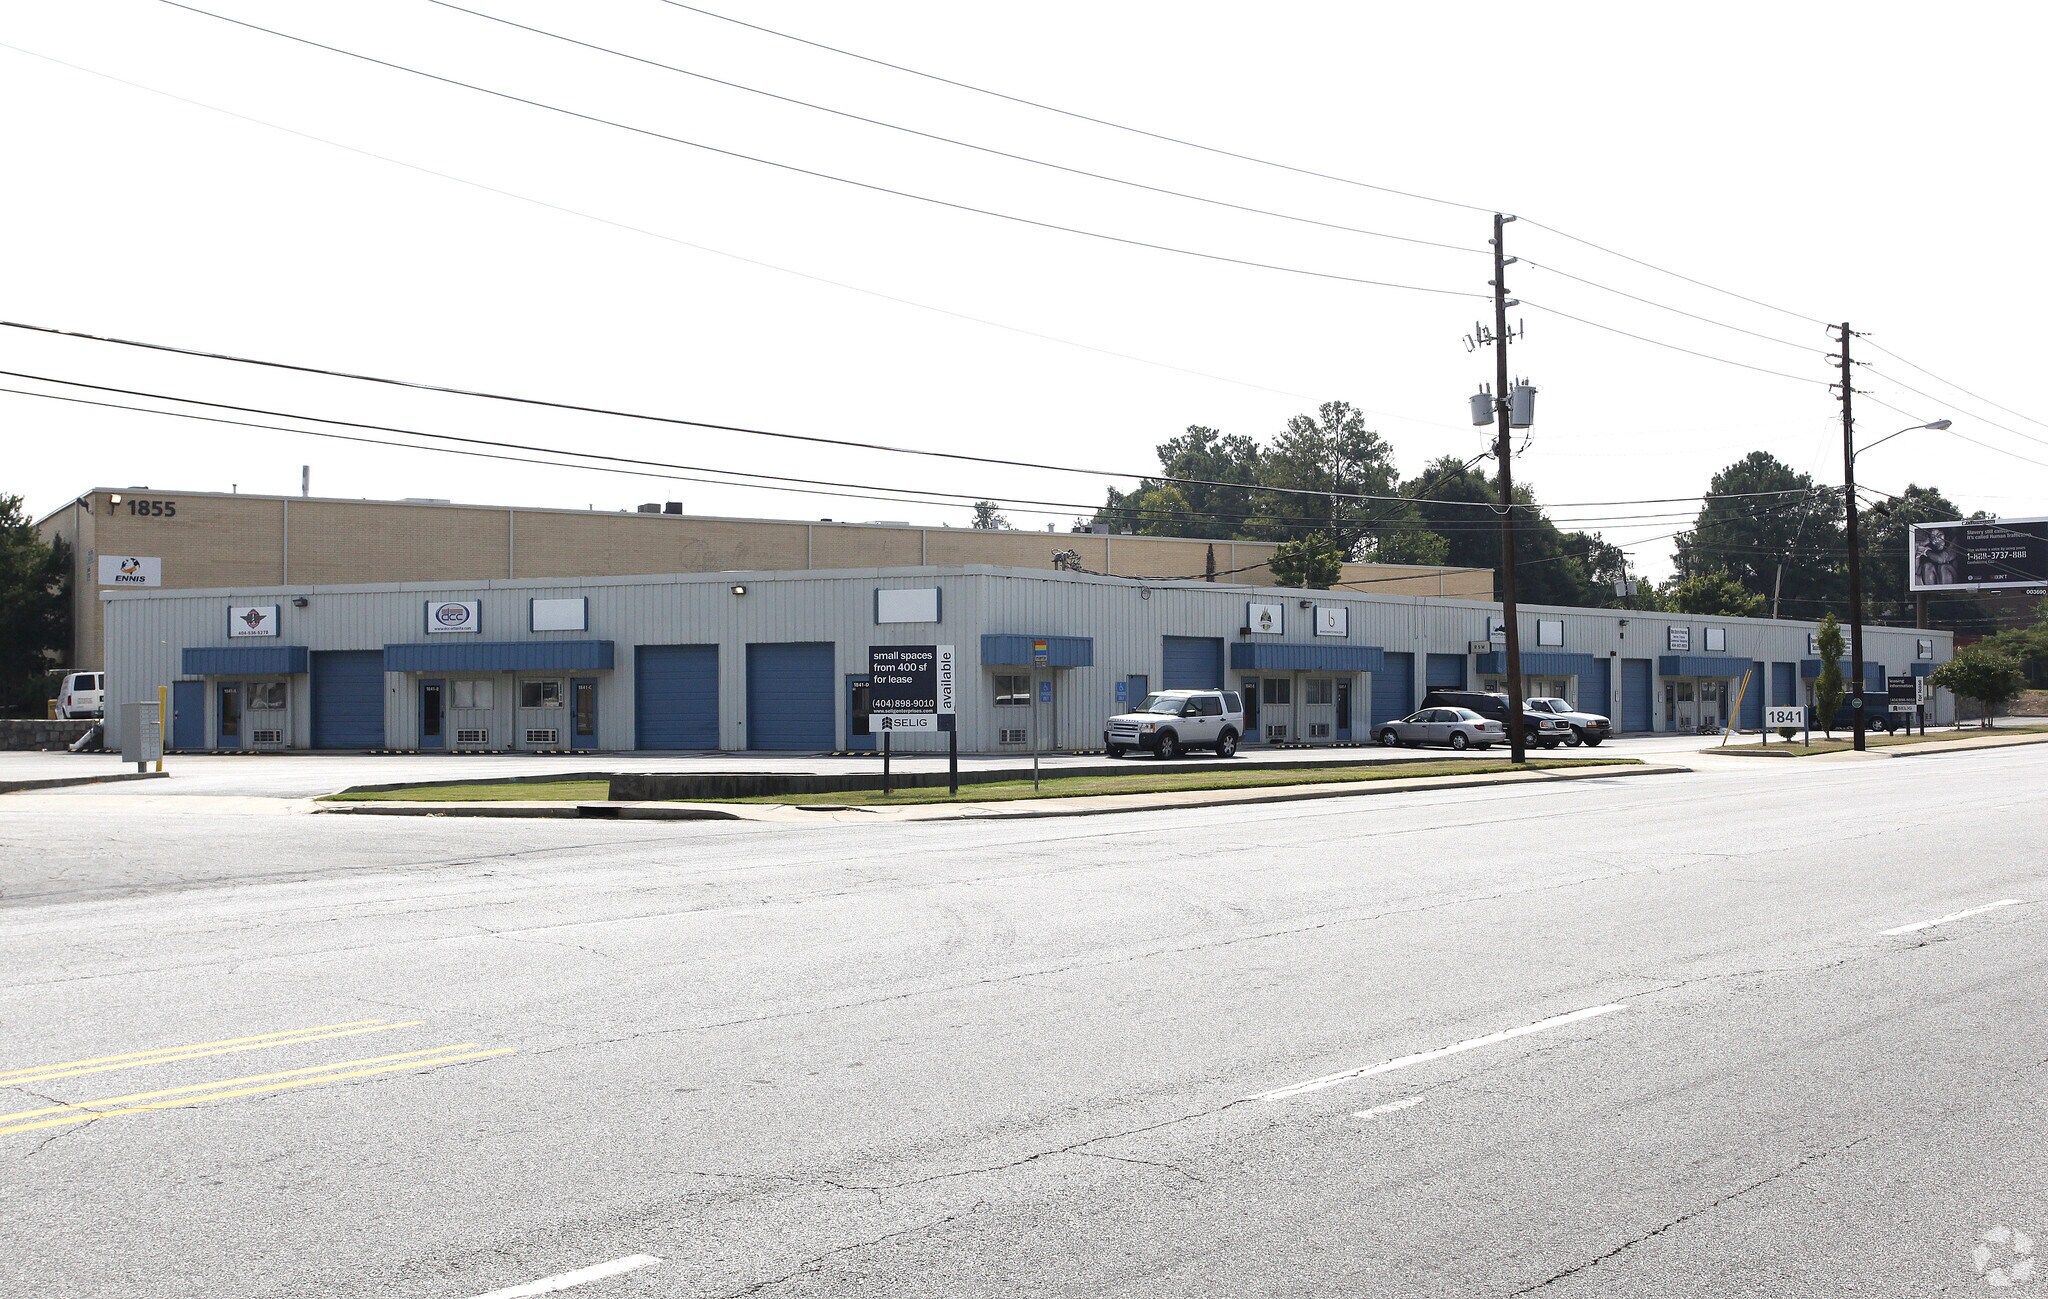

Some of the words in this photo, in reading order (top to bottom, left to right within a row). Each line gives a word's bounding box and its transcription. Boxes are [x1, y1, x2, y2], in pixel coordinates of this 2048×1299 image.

[127, 500, 176, 517] 1855
[115, 575, 146, 583] ENNIS
[873, 651, 899, 660] small
[900, 652, 933, 662] spaces
[873, 663, 896, 672] from
[897, 663, 917, 672] 400
[918, 663, 928, 672] sf
[873, 675, 887, 684] for
[888, 675, 913, 684] lease
[940, 652, 952, 709] available
[1768, 711, 1802, 723] 1841
[893, 718, 928, 727] SELIG
